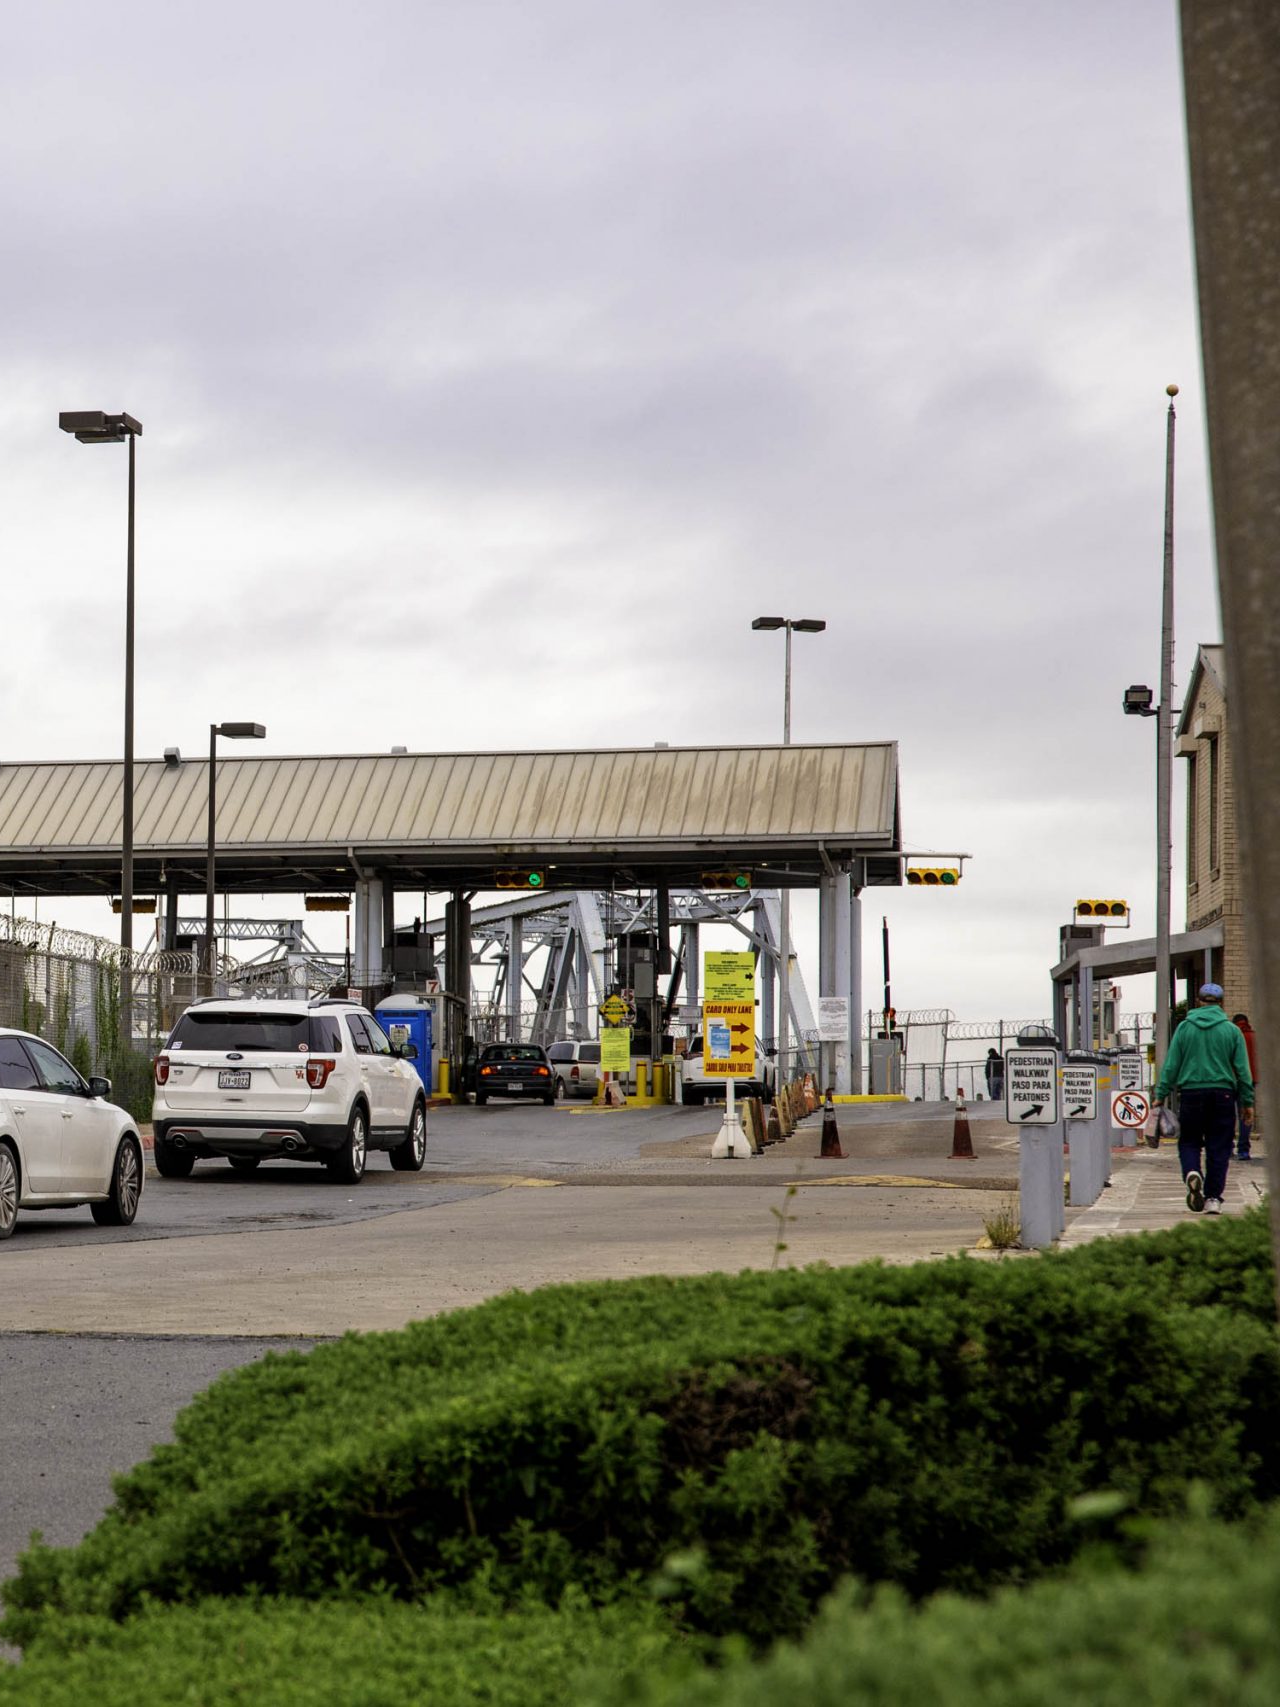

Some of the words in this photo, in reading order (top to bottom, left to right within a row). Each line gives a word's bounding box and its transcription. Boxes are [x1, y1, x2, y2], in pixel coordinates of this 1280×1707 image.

[428, 982, 438, 993] 7
[722, 1005, 737, 1014] ONLY
[738, 1005, 752, 1014] LANE
[1009, 1057, 1053, 1066] PEDESTRIAN
[1013, 1069, 1049, 1078] WALKWAY
[1012, 1081, 1031, 1090] PASO
[1032, 1081, 1051, 1090] PARA
[1013, 1093, 1050, 1102] PEATONES
